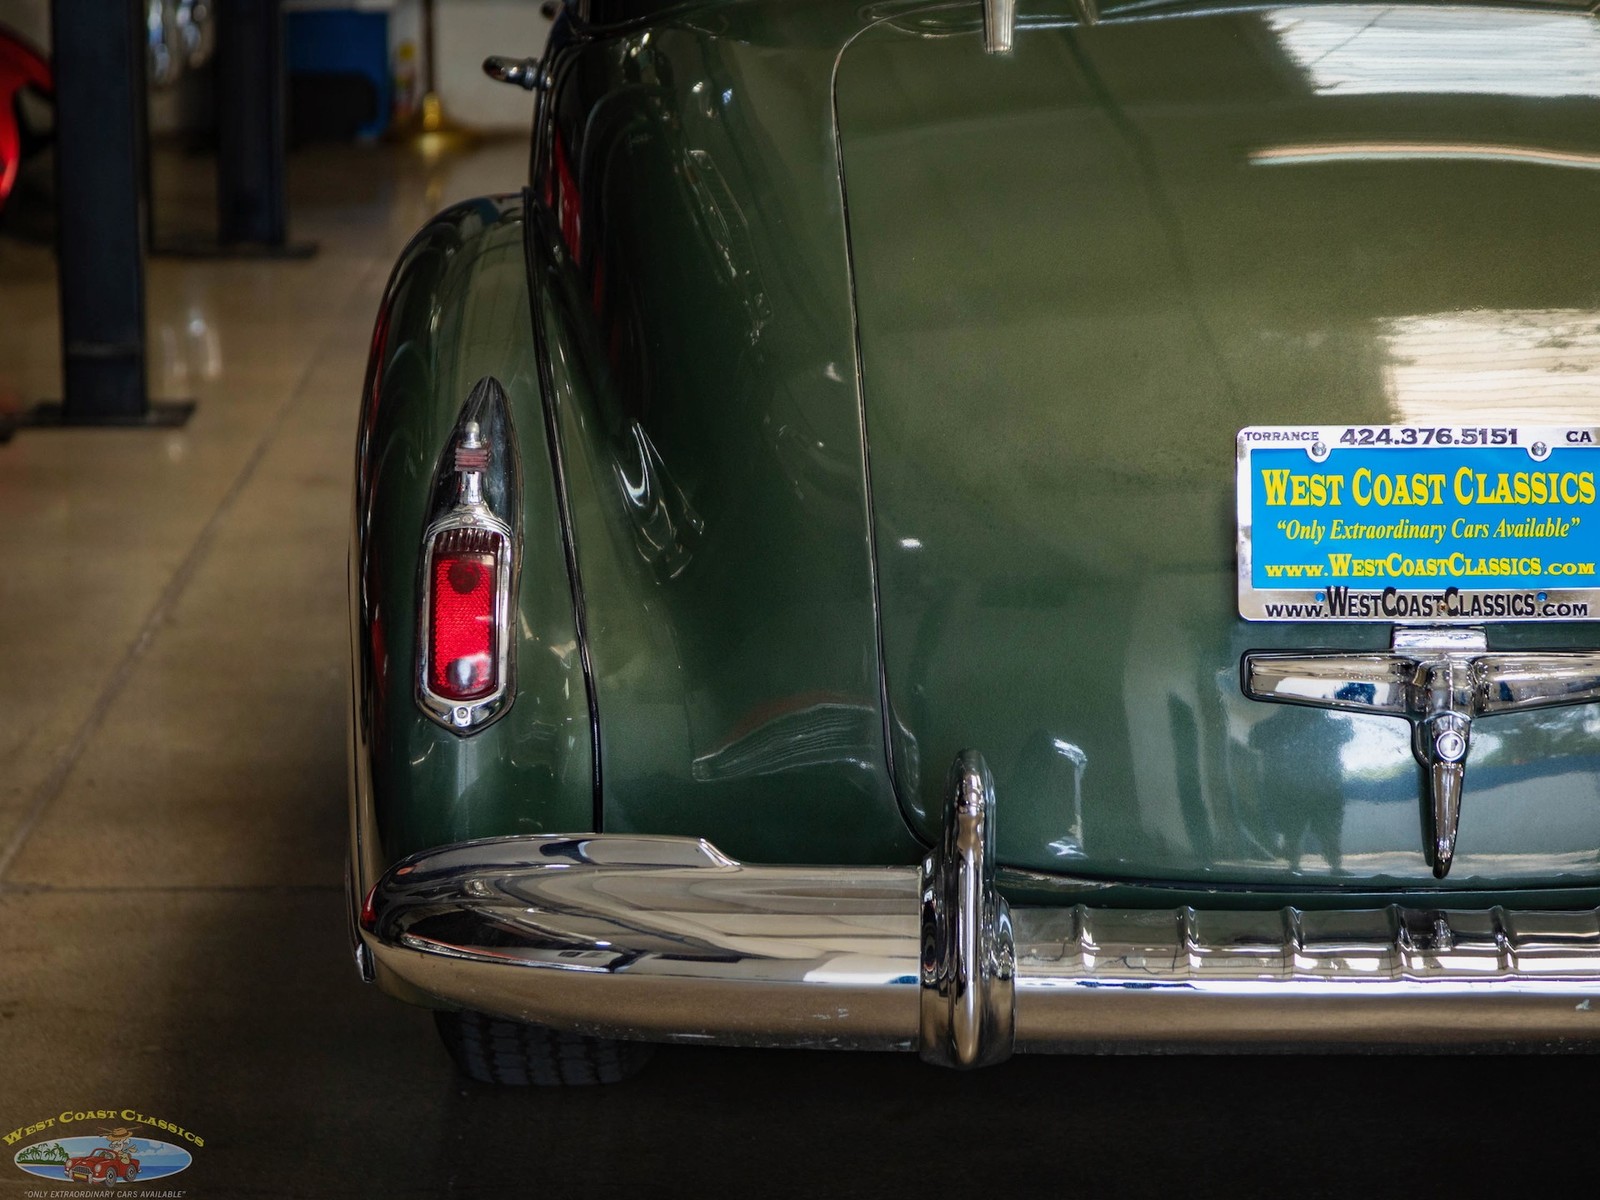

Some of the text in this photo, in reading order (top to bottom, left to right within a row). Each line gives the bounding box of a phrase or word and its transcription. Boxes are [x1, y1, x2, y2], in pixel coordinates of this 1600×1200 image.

[1244, 428, 1593, 446] TORRANCE 424.376.5151 CA
[1261, 466, 1596, 507] WEST COAST CLASSICS
[1330, 518, 1447, 544] Extraordinary
[1451, 517, 1490, 539] Cars
